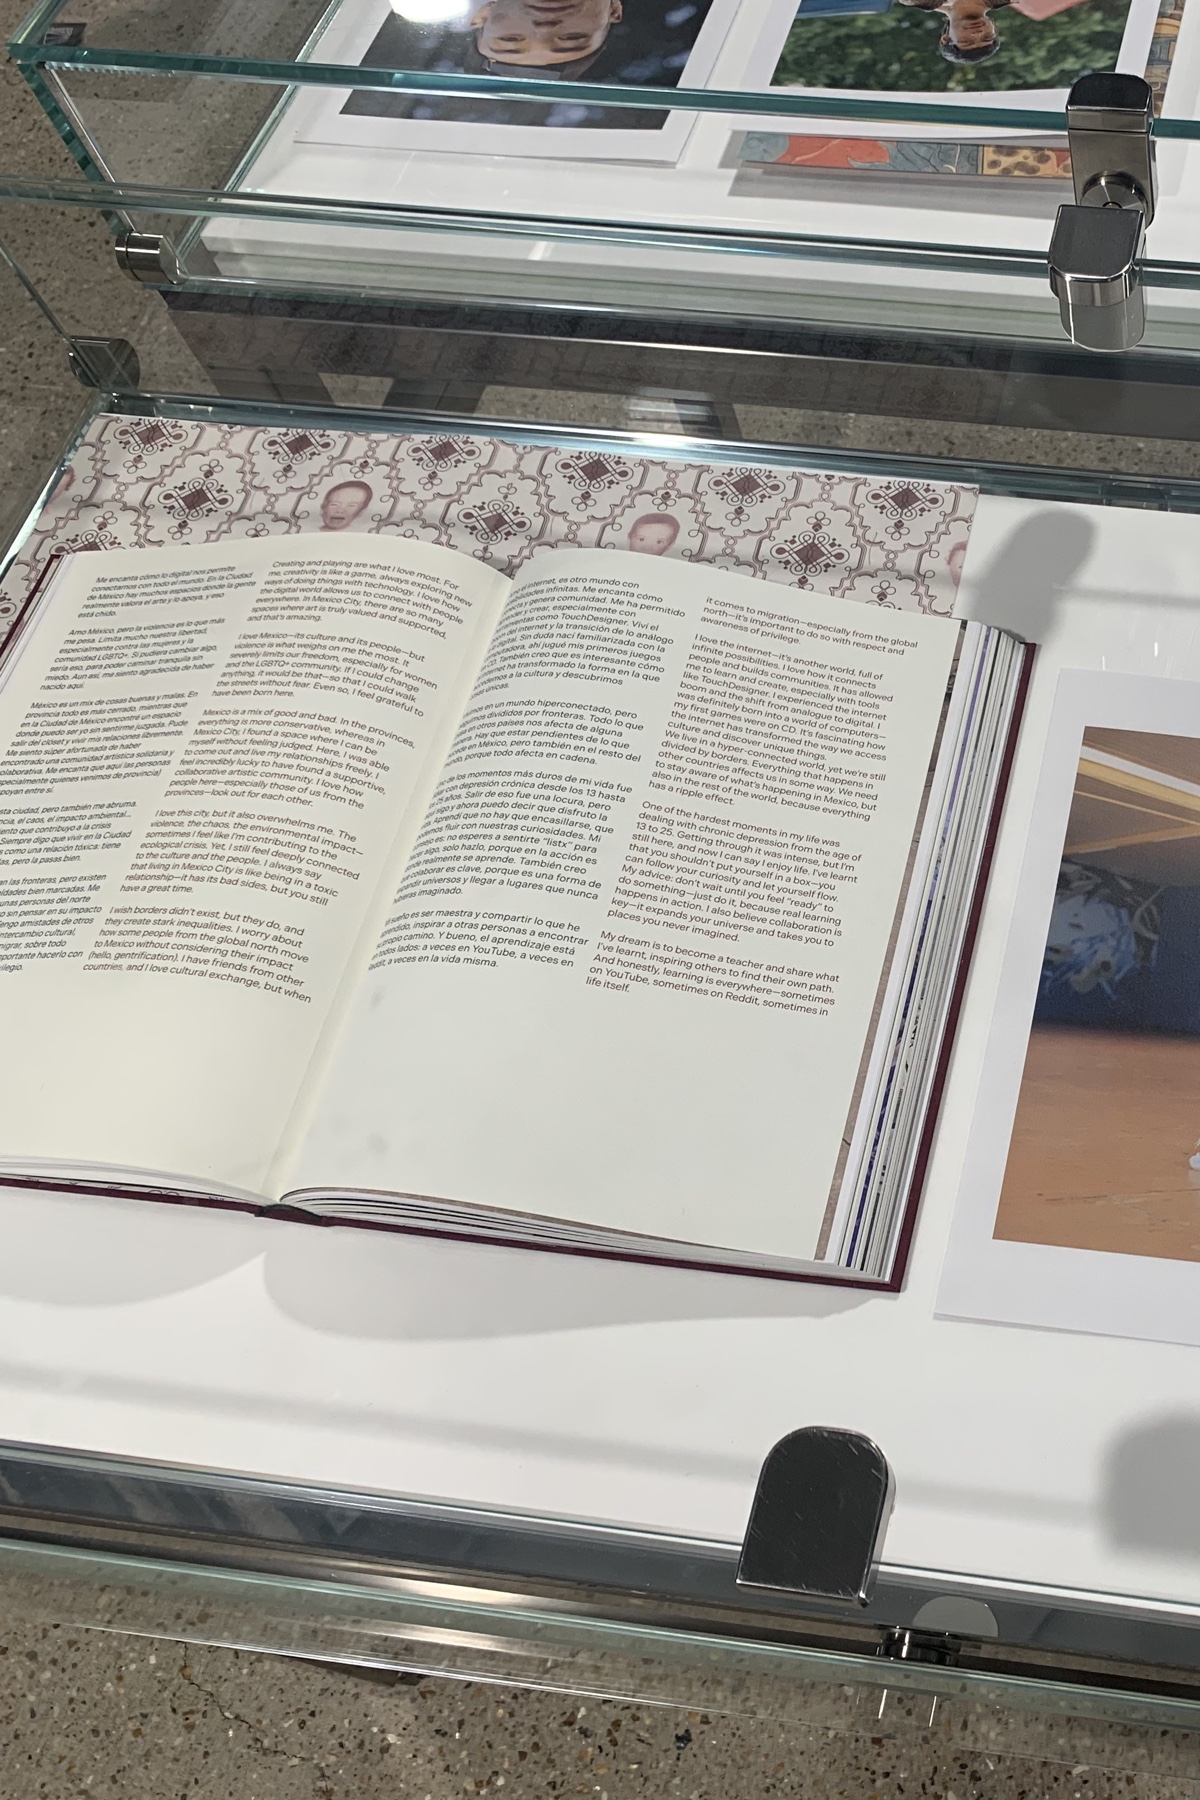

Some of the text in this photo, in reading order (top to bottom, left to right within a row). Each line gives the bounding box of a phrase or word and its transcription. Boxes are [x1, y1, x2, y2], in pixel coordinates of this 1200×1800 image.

[700, 616, 801, 645] awareness of privilege.
[713, 599, 745, 612] comes
[746, 606, 756, 615] to
[852, 629, 874, 641] from
[874, 634, 890, 644] the
[890, 638, 919, 648] global
[749, 616, 795, 634] important
[795, 627, 806, 636] to
[806, 630, 819, 639] do
[819, 634, 831, 642] so
[832, 636, 851, 646] with
[852, 641, 887, 653] respect
[887, 647, 905, 656] and
[691, 643, 724, 657] infinite
[724, 651, 781, 670] possibilities.
[786, 664, 806, 676] love
[806, 668, 827, 680] how
[834, 676, 877, 690] connects
[699, 634, 719, 646] love
[719, 639, 735, 649] the
[792, 657, 829, 670] another
[829, 665, 856, 677] world,
[858, 669, 873, 679] full
[873, 673, 884, 681] of
[636, 821, 647, 831] 13
[647, 824, 659, 834] to
[659, 826, 675, 837] 25.
[676, 830, 714, 847] Getting
[715, 838, 754, 854] through
[763, 849, 783, 859] was
[783, 852, 821, 868] intense,
[822, 859, 840, 870] but
[840, 862, 855, 872] I'm
[638, 811, 863, 862] dealing with chronic depression from the age of
[641, 800, 841, 848] One of the hardest moments in my life was
[104, 917, 124, 927] they
[123, 918, 152, 926] create
[151, 918, 176, 926] stark
[241, 928, 271, 941] worry
[271, 934, 303, 949] about
[113, 906, 133, 914] wish
[133, 905, 168, 915] borders
[222, 911, 241, 922] but
[242, 914, 266, 928] they
[283, 925, 306, 937] and
[412, 921, 446, 930] inspirar
[453, 921, 480, 930] otras
[479, 923, 528, 936] personas
[537, 930, 590, 946] encontrar
[420, 910, 435, 918] ser
[435, 909, 474, 918] maestra
[481, 911, 533, 924] compartir
[533, 916, 544, 926] lo
[544, 920, 566, 930] que
[566, 922, 581, 933] he
[479, 933, 491, 943] el
[490, 936, 551, 952] aprendizaje
[552, 945, 576, 956] está
[592, 953, 836, 1006] And honestly, learning is everywhere—sometimes
[596, 941, 834, 994] I've learnt, inspiring others to find their own path.
[600, 930, 617, 943] My
[617, 934, 651, 948] dream
[651, 940, 661, 951] is
[662, 943, 674, 953] to
[674, 945, 716, 961] become
[725, 956, 765, 970] teacher
[765, 964, 786, 974] and
[785, 967, 814, 979] share
[815, 972, 840, 983] what
[585, 975, 630, 993] life itself.
[589, 966, 829, 1017] on YouTube, sometimes on Reddit, sometimes in
